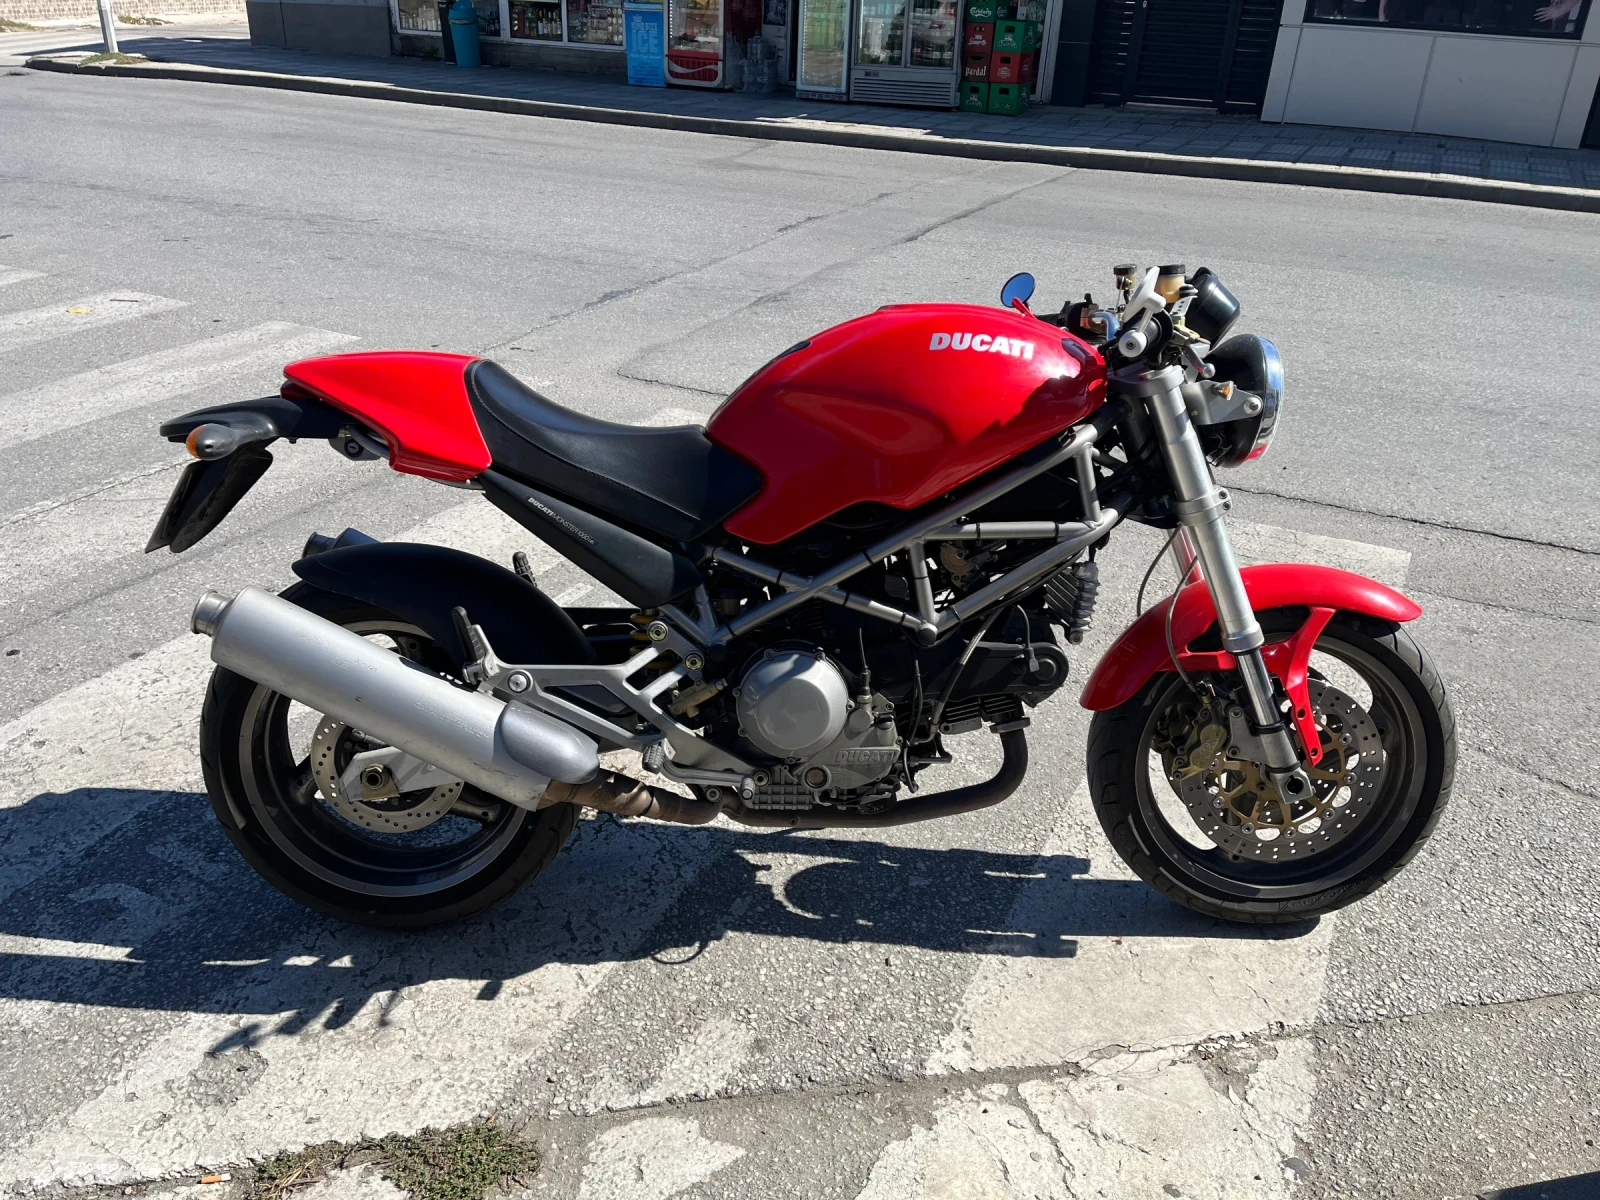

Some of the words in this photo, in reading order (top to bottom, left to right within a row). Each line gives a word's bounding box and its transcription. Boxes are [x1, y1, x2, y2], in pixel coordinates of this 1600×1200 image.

[632, 30, 658, 53] ICE
[929, 332, 1035, 360] DUCATI
[527, 497, 554, 516] DUCATI
[835, 750, 896, 764] DUCATI
